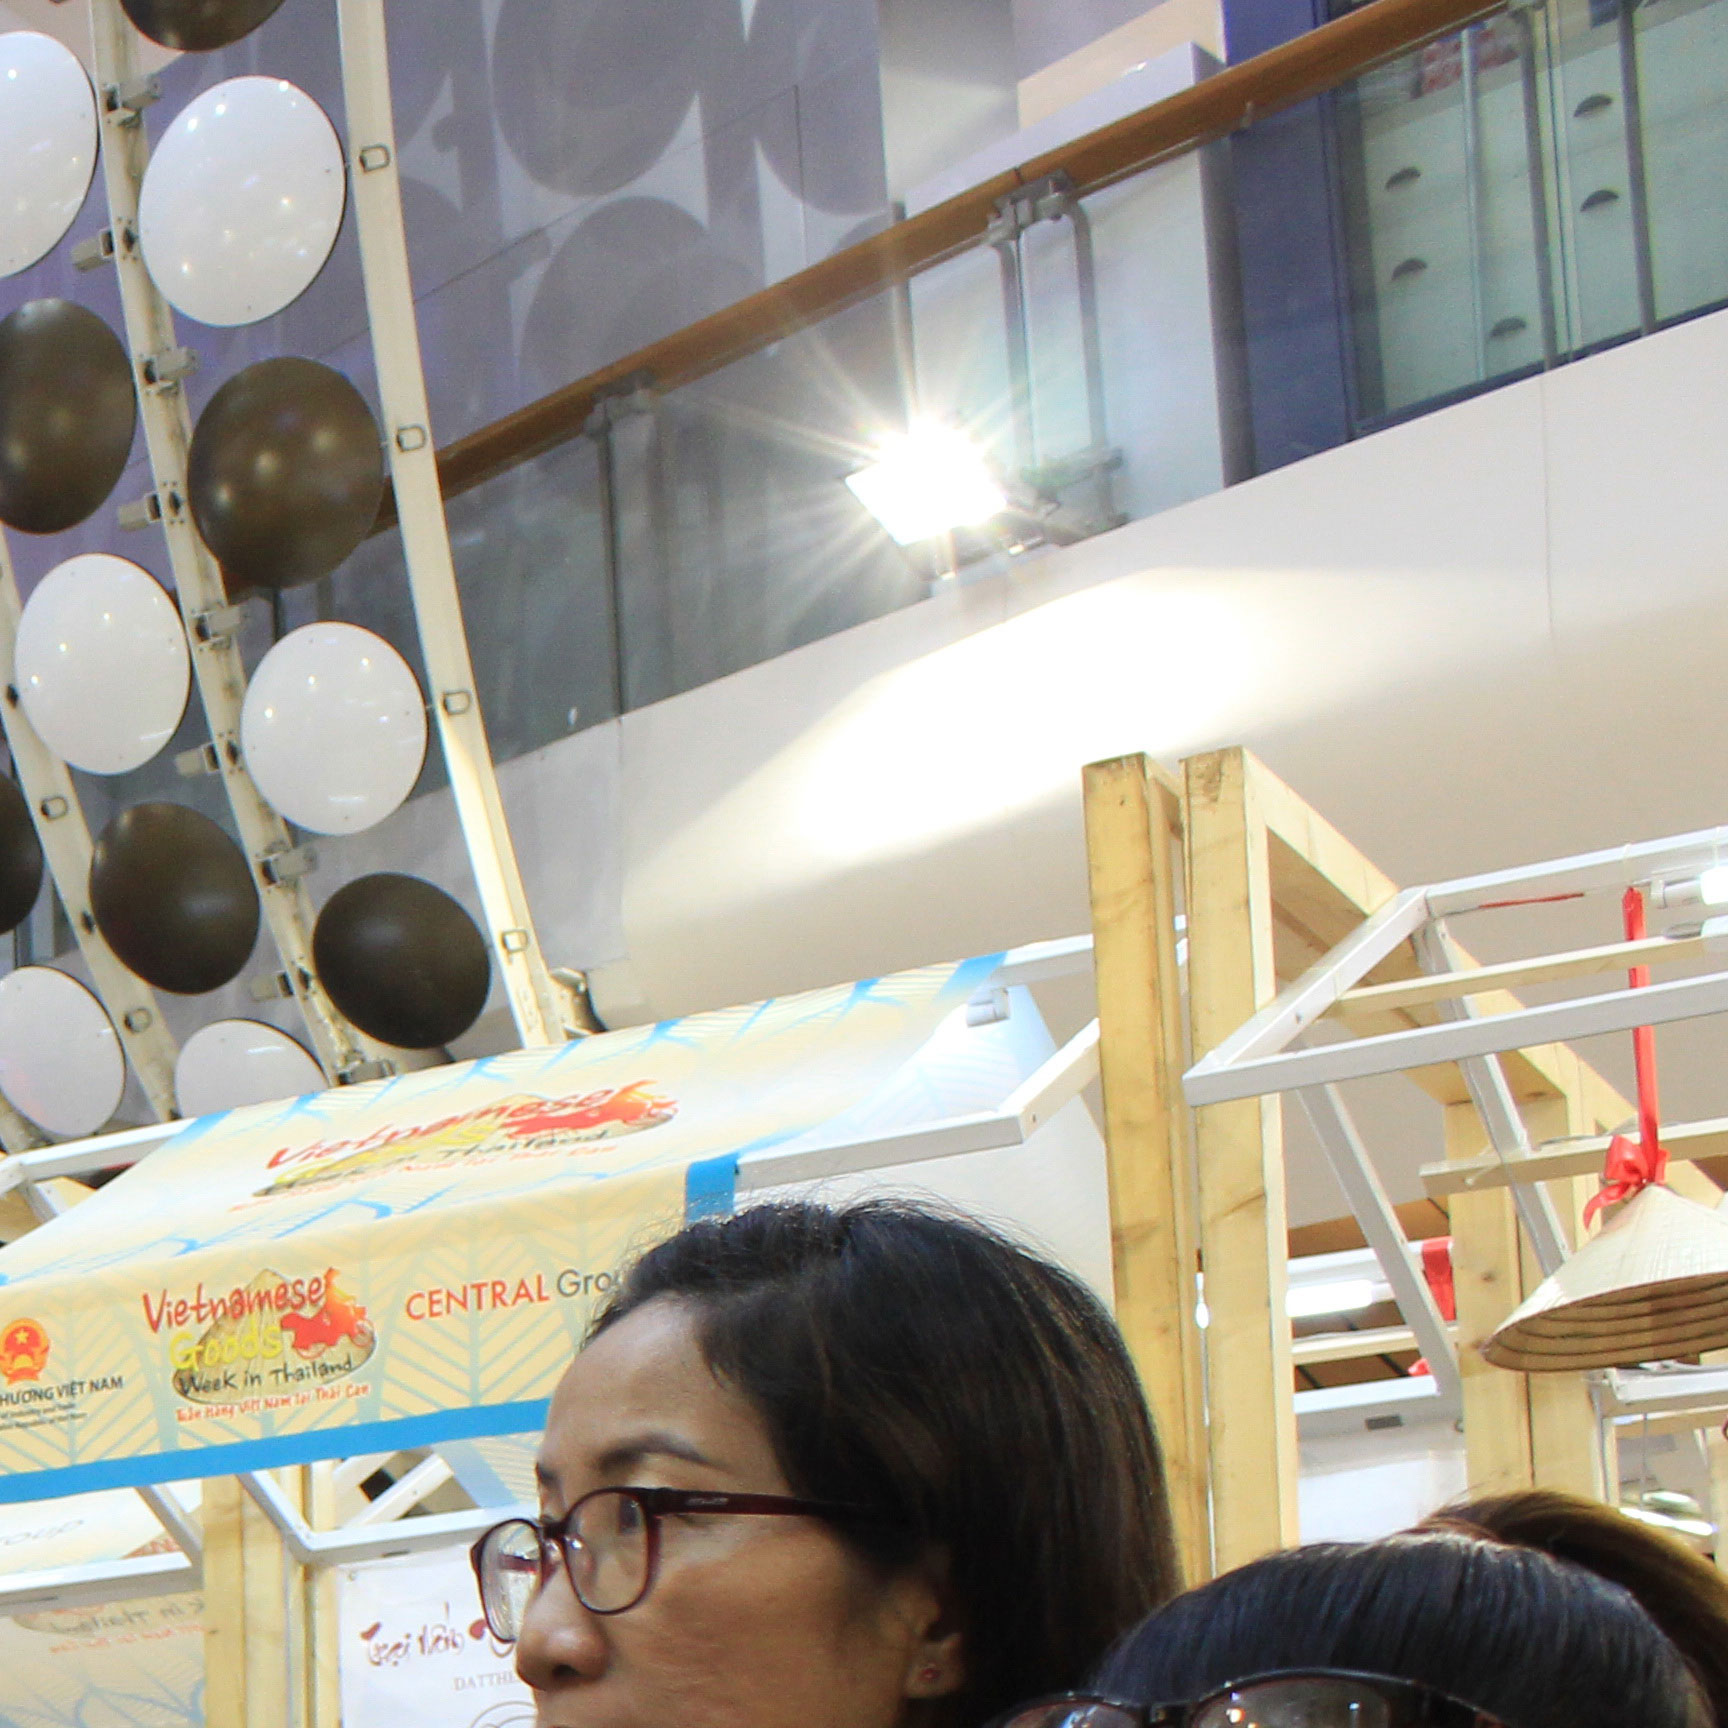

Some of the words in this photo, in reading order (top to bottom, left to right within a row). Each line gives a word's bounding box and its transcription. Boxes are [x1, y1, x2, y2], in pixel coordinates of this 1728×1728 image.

[266, 1089, 613, 1170] Vietnamese
[141, 1276, 323, 1335] Vietnamese
[405, 1273, 551, 1321] CENTRAL
[170, 1319, 284, 1372] Goods
[56, 1378, 87, 1399] VIỆT
[89, 1375, 124, 1393] NAM
[177, 1370, 239, 1397] Week
[244, 1369, 263, 1387] in
[268, 1354, 354, 1386] Thailand
